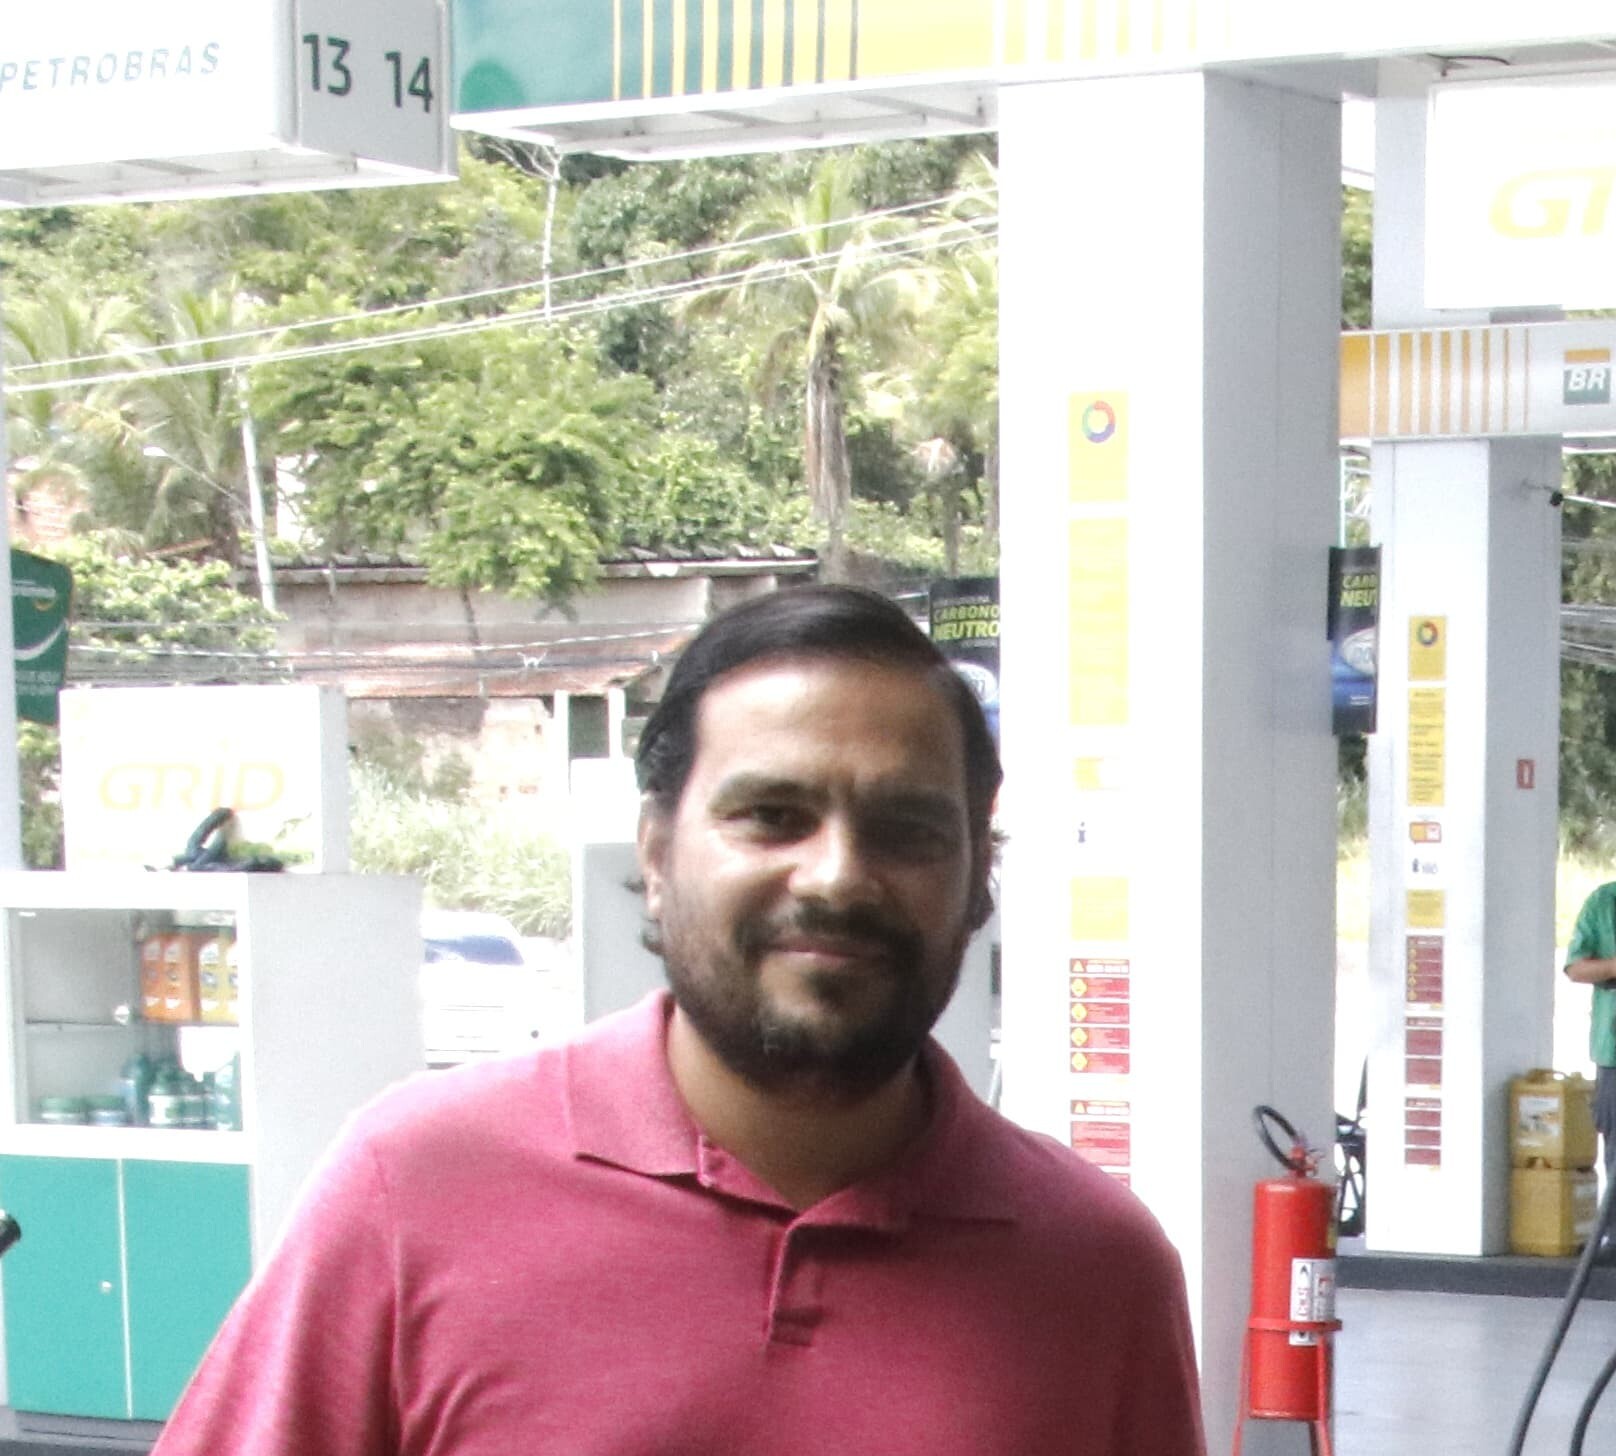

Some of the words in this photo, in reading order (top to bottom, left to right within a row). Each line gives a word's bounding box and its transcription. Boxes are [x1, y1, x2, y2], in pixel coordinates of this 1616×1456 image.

[0, 42, 222, 92] PETROBRAS
[302, 33, 353, 97] 13
[384, 51, 434, 113] 14
[934, 604, 1000, 622] CARBONO
[934, 621, 1000, 640] NEUTRO
